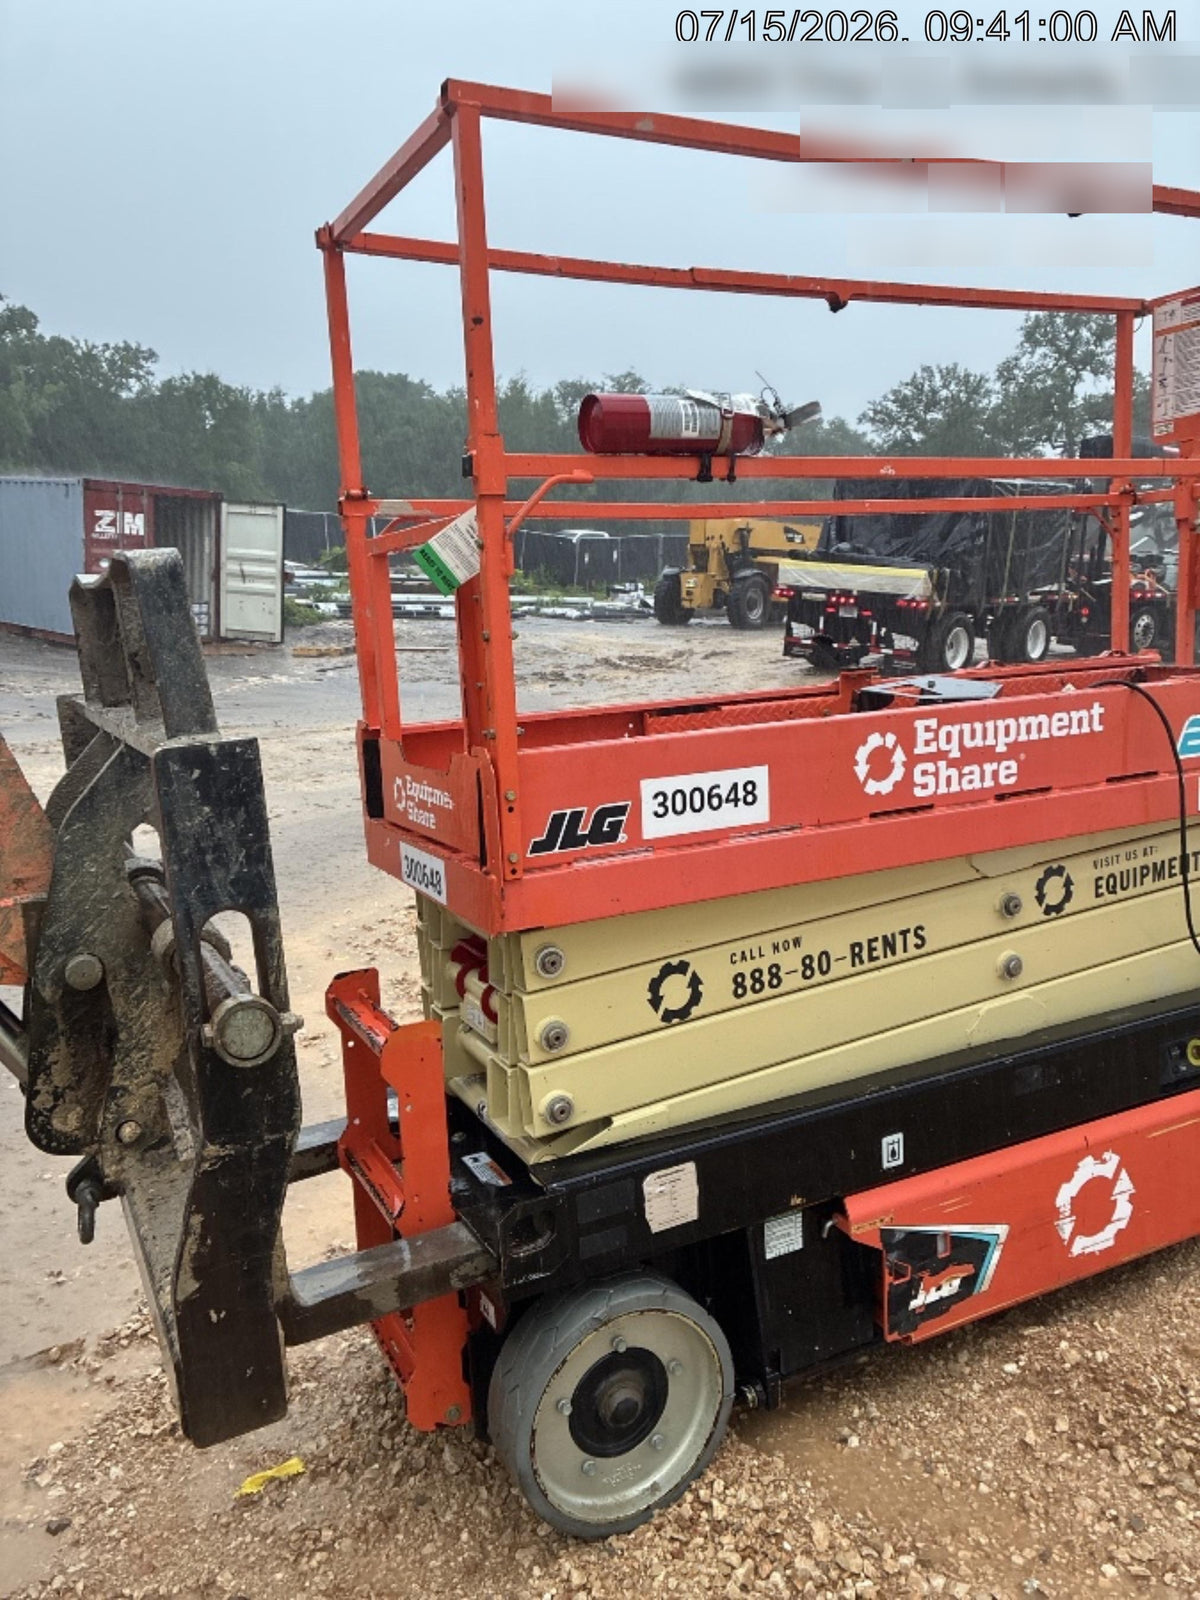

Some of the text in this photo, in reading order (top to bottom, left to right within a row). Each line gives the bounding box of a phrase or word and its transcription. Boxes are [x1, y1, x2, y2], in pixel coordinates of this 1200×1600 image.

[93, 509, 145, 536] ZIM
[913, 701, 1105, 758] Equipment
[912, 759, 1018, 798] Share
[652, 779, 759, 819] 300648
[526, 800, 632, 857] JLG
[404, 854, 442, 896] 300648
[1092, 854, 1121, 870] VISIT
[1125, 849, 1139, 861] US
[729, 935, 804, 965] CALL NOW
[731, 924, 928, 999] 888-80-RENTS
